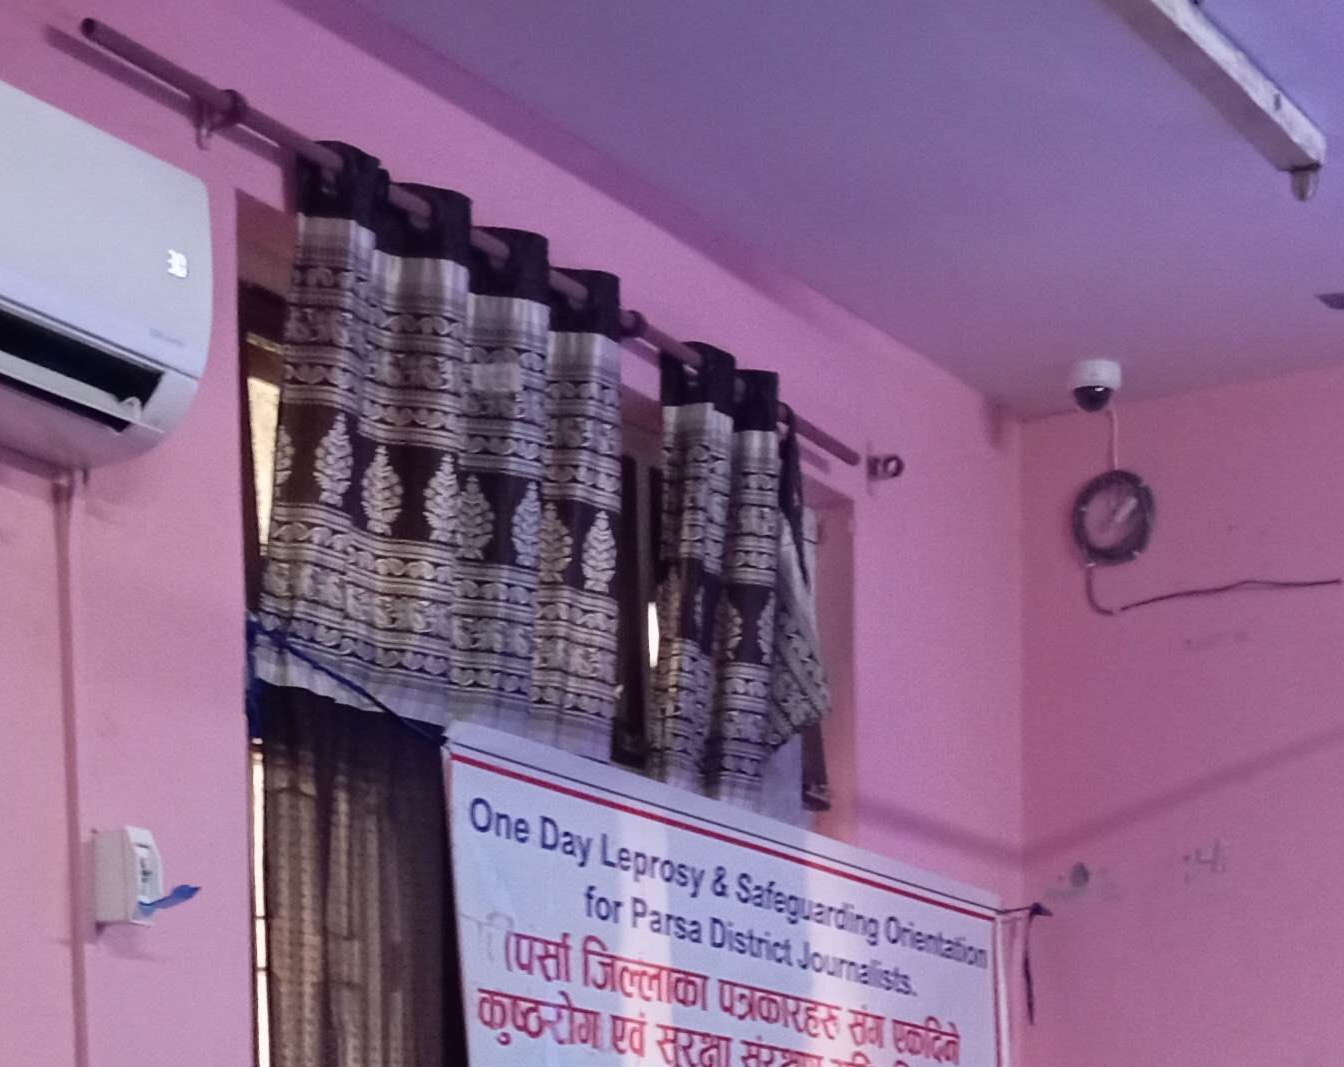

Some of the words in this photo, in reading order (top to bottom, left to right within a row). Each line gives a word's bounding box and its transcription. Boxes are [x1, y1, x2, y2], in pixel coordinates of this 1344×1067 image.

[469, 797, 530, 844] One
[539, 815, 593, 868] Day
[601, 833, 706, 898] Leprosy
[711, 865, 729, 898] &
[735, 873, 880, 947] Safeguarding
[884, 915, 989, 969] Orientation
[584, 885, 624, 924] for
[631, 896, 703, 944] Parsa
[710, 917, 793, 967] District
[610, 1011, 648, 1057] एवं
